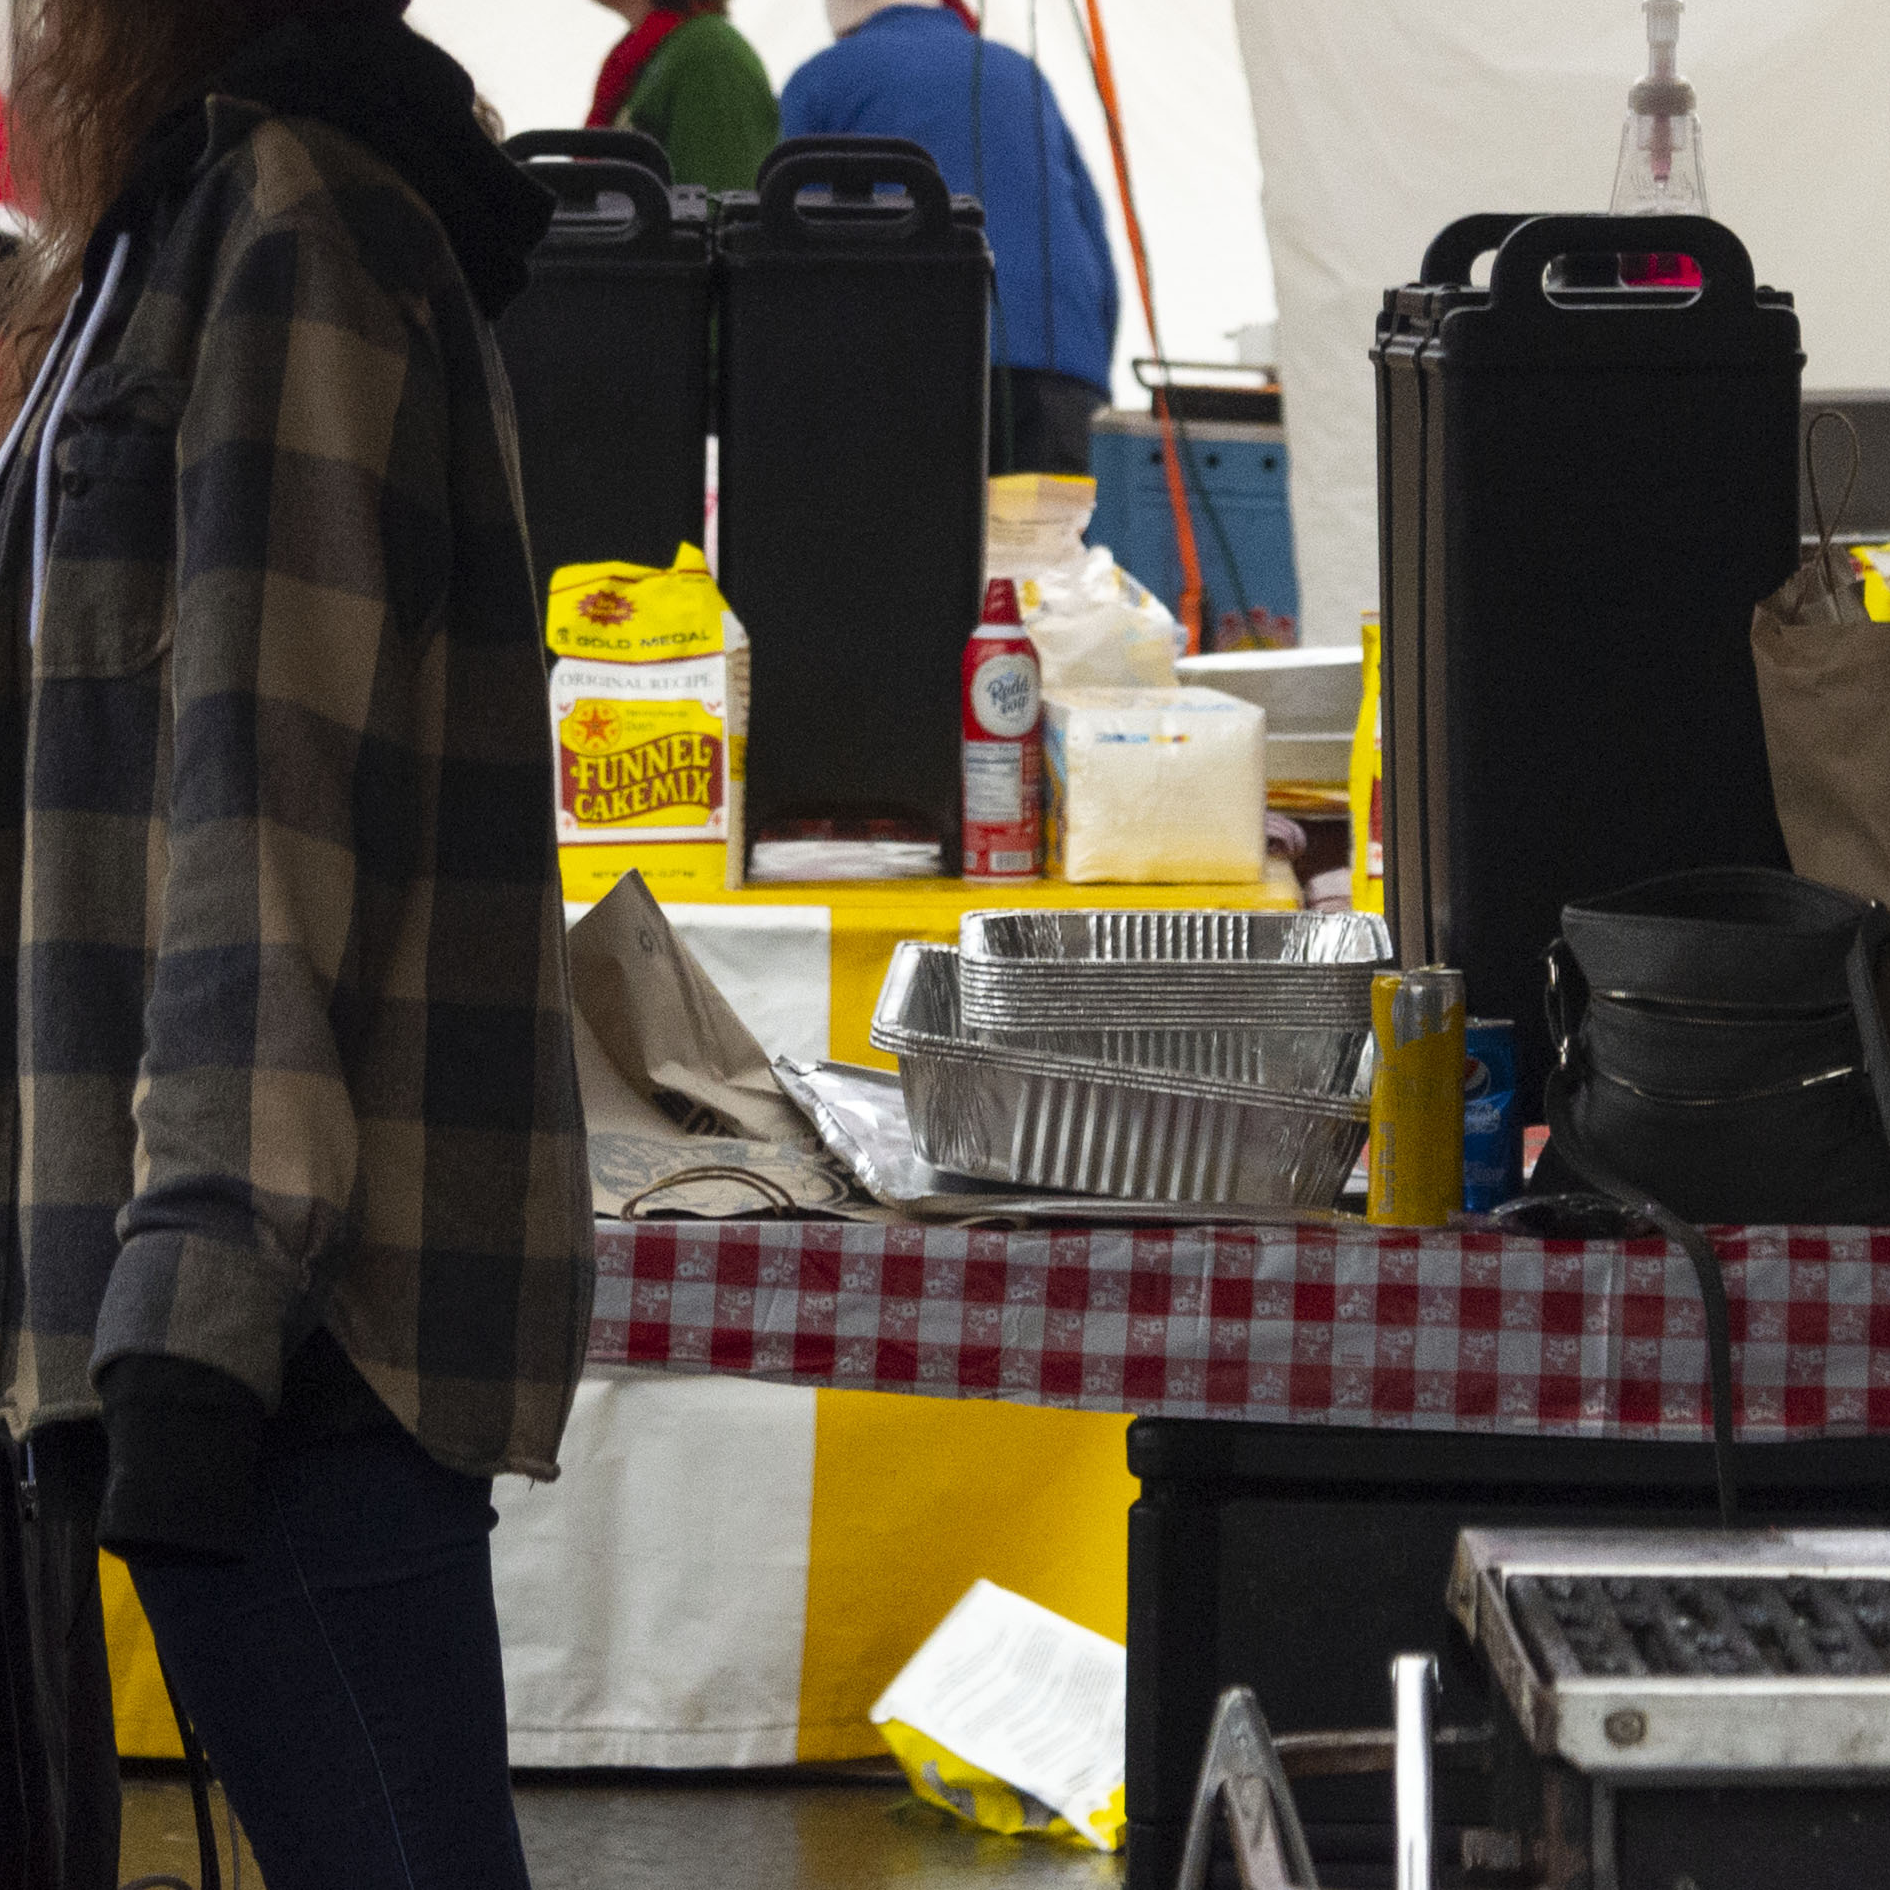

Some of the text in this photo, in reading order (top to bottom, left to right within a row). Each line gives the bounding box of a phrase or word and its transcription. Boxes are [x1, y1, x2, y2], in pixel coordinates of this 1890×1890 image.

[575, 628, 711, 650] GOLD MEDAL
[570, 732, 713, 792] FUNNEL
